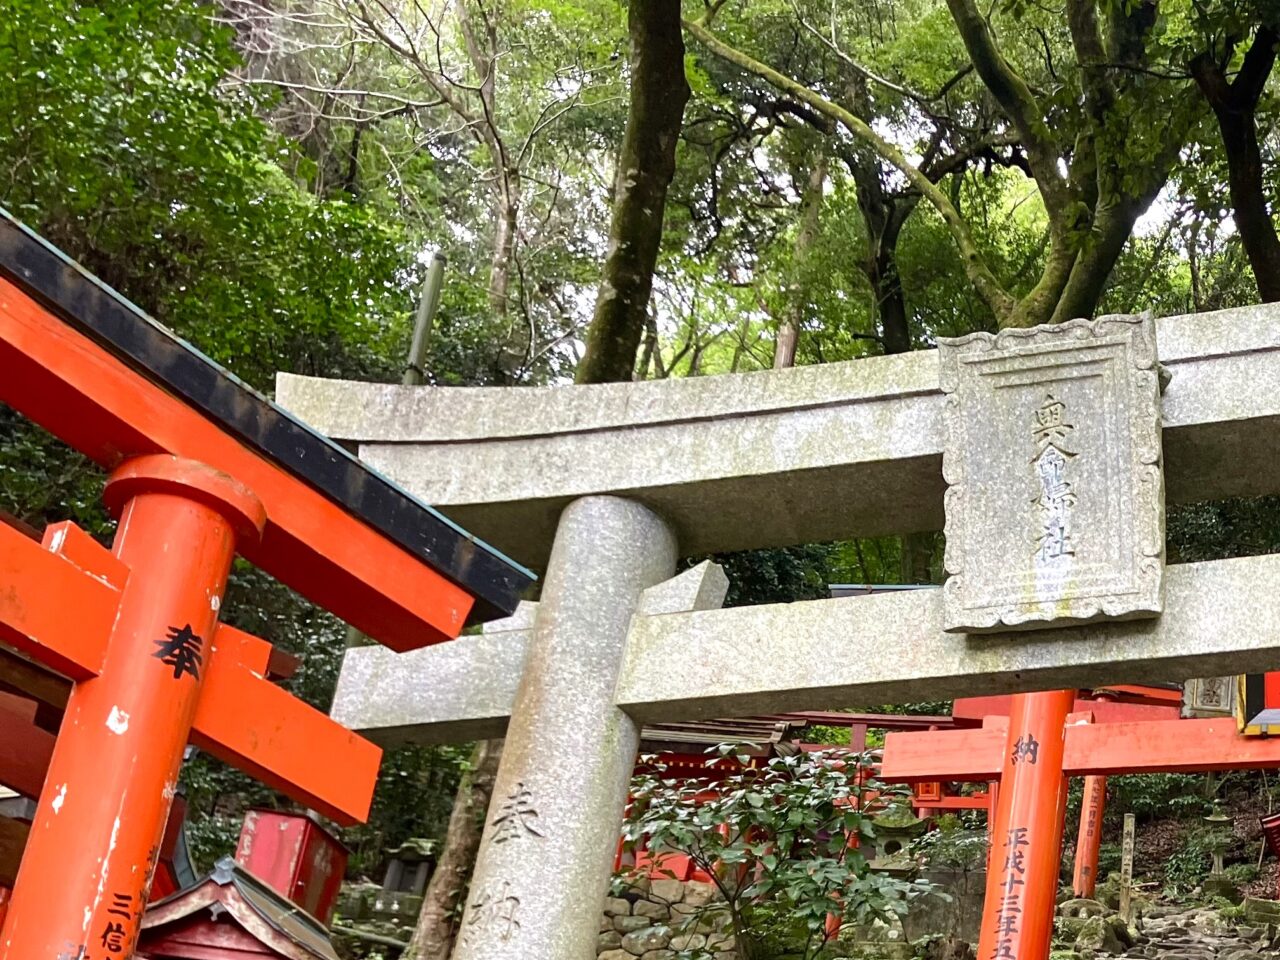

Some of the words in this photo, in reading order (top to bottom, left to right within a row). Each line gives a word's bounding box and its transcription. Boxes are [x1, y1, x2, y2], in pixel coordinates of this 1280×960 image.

[1029, 393, 1080, 562] 奥命婦社
[152, 624, 203, 680] 奉
[1011, 734, 1039, 765] 納
[462, 783, 544, 943] 奉納
